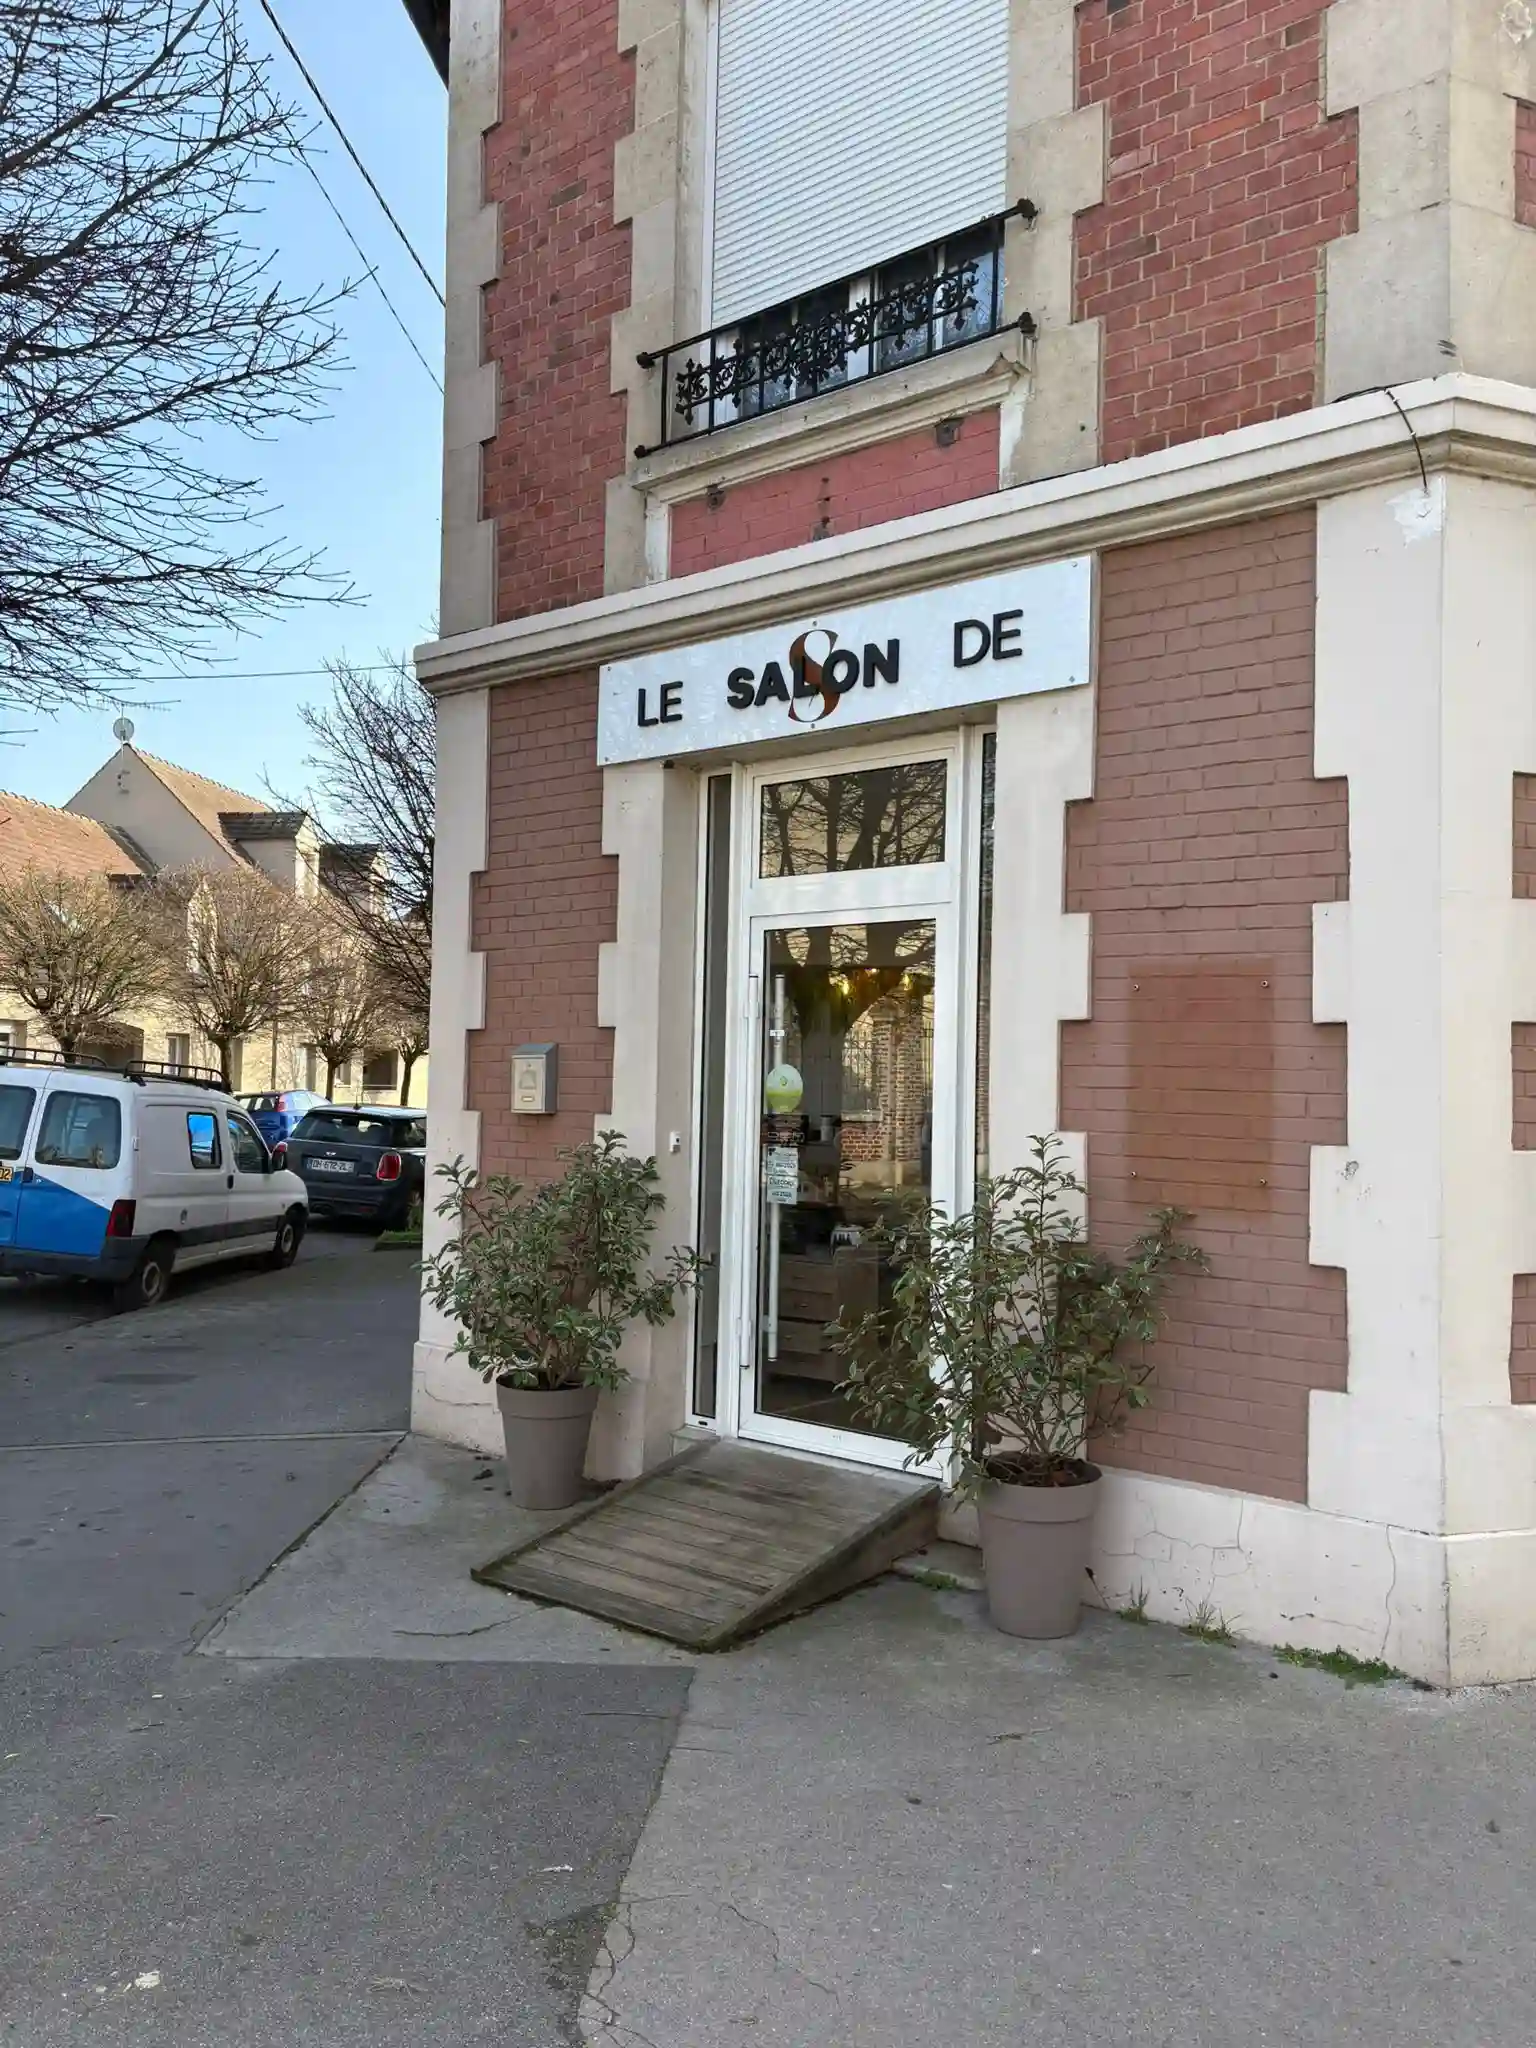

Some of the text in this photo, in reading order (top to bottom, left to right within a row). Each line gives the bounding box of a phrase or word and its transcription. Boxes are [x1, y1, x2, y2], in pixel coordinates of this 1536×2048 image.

[637, 608, 1024, 727] LE SALON DE
